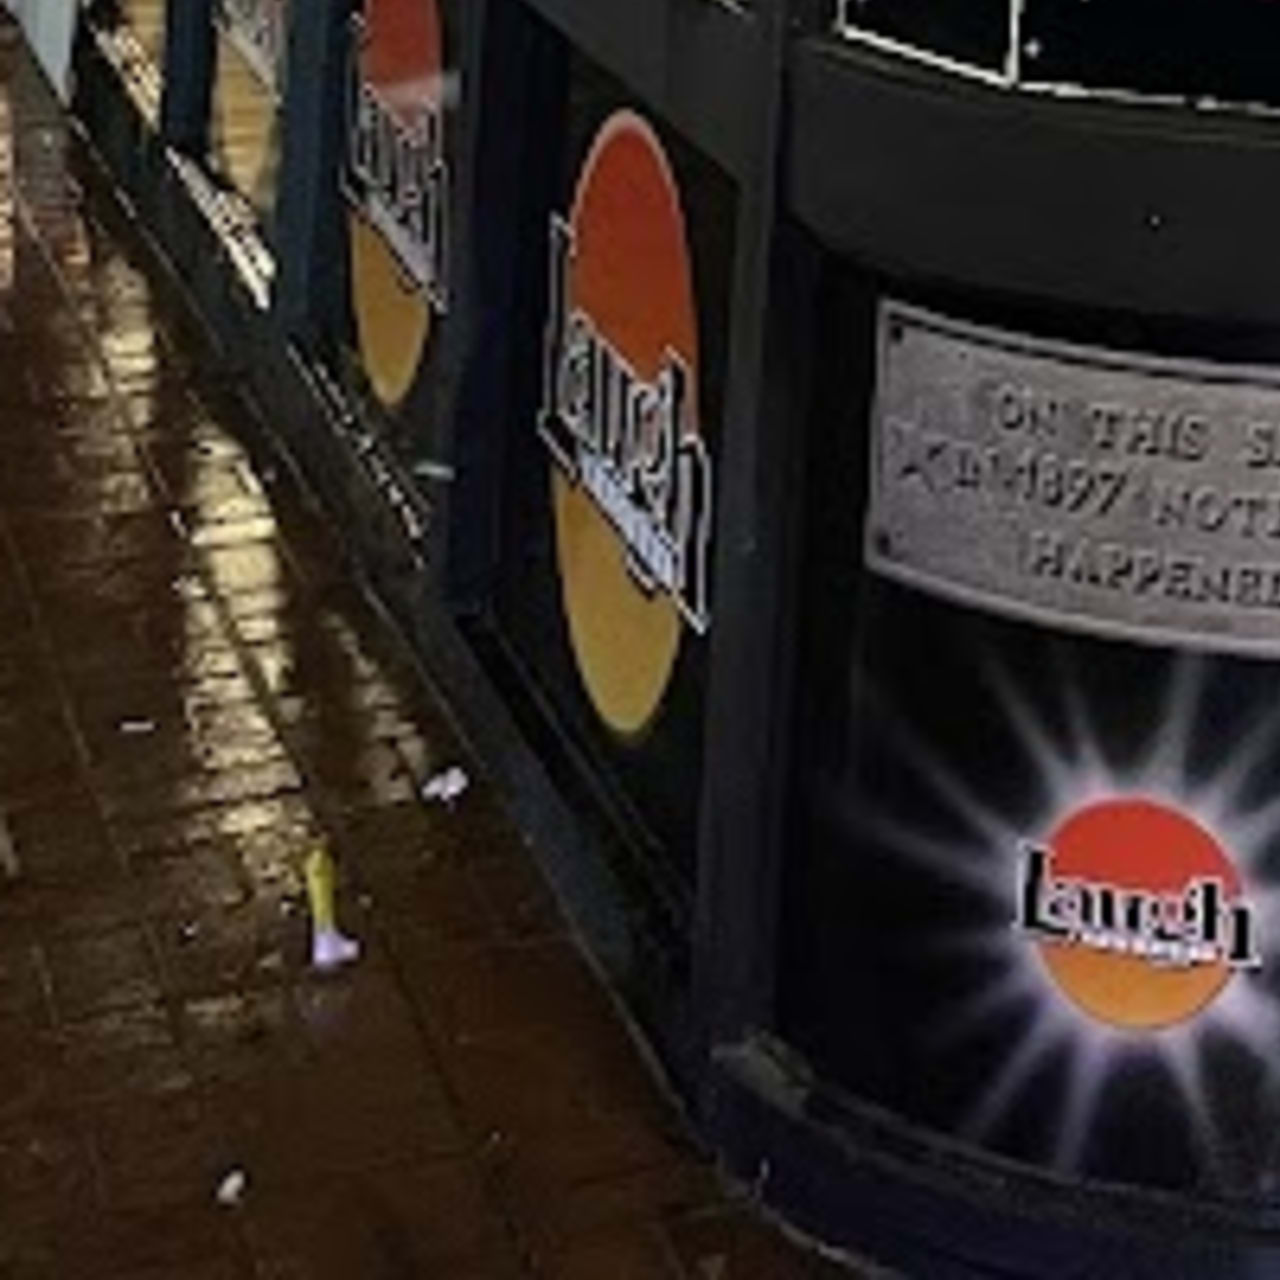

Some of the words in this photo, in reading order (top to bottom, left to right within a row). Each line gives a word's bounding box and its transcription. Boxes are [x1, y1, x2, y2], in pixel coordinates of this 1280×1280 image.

[999, 382, 1060, 438] ON
[1095, 402, 1208, 464] THIS
[1012, 840, 1262, 968] Laugh
